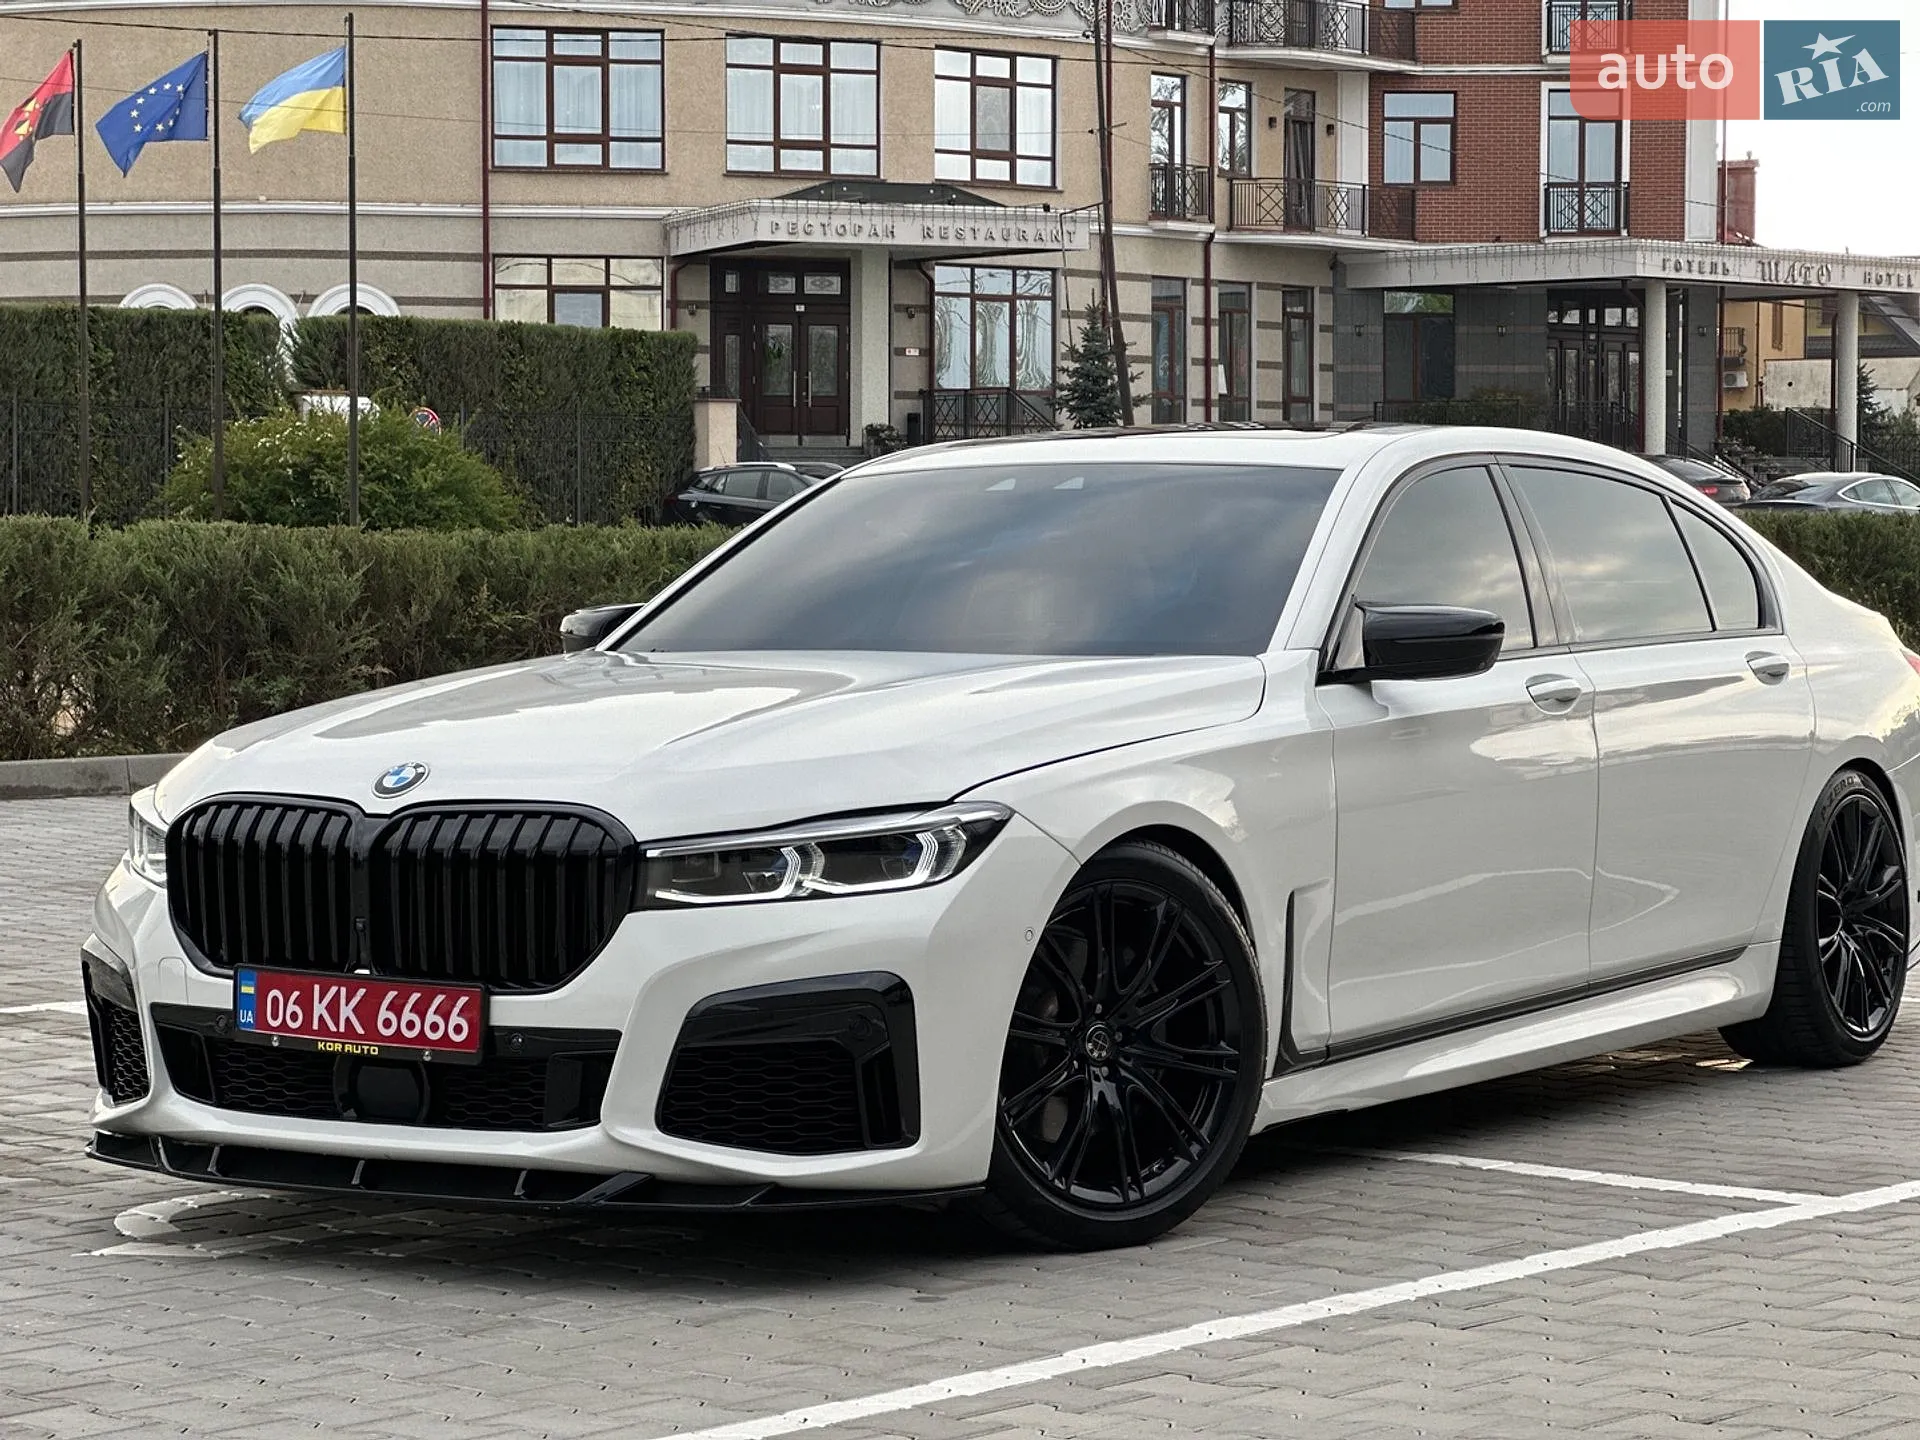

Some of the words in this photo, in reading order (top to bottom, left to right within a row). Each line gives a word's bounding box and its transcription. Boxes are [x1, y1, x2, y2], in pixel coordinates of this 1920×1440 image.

[770, 221, 896, 239] РЕСТОРАН
[922, 225, 1077, 243] RESTAURANT
[1863, 271, 1914, 288] HOTEL
[239, 1010, 254, 1024] UA
[266, 989, 303, 1029] 06
[312, 984, 366, 1034] KK
[377, 991, 470, 1042] 6666
